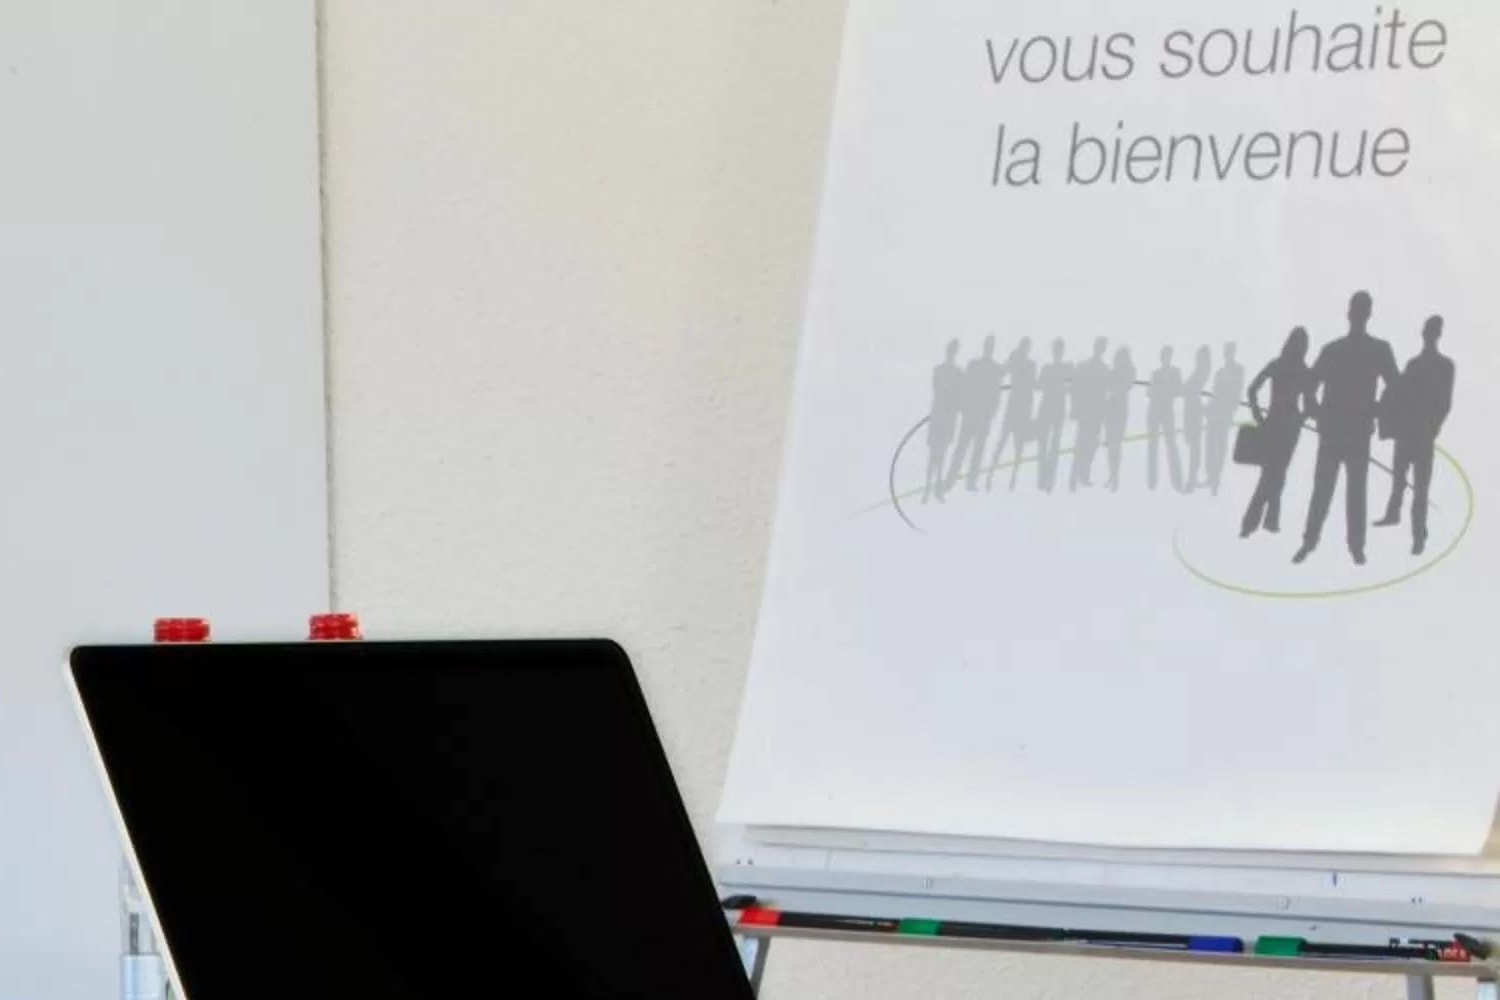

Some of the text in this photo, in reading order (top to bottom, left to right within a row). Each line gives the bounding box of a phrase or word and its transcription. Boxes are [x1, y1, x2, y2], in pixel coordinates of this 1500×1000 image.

[985, 5, 1448, 85] vous souhaite
[990, 120, 1411, 188] la bienvenue
